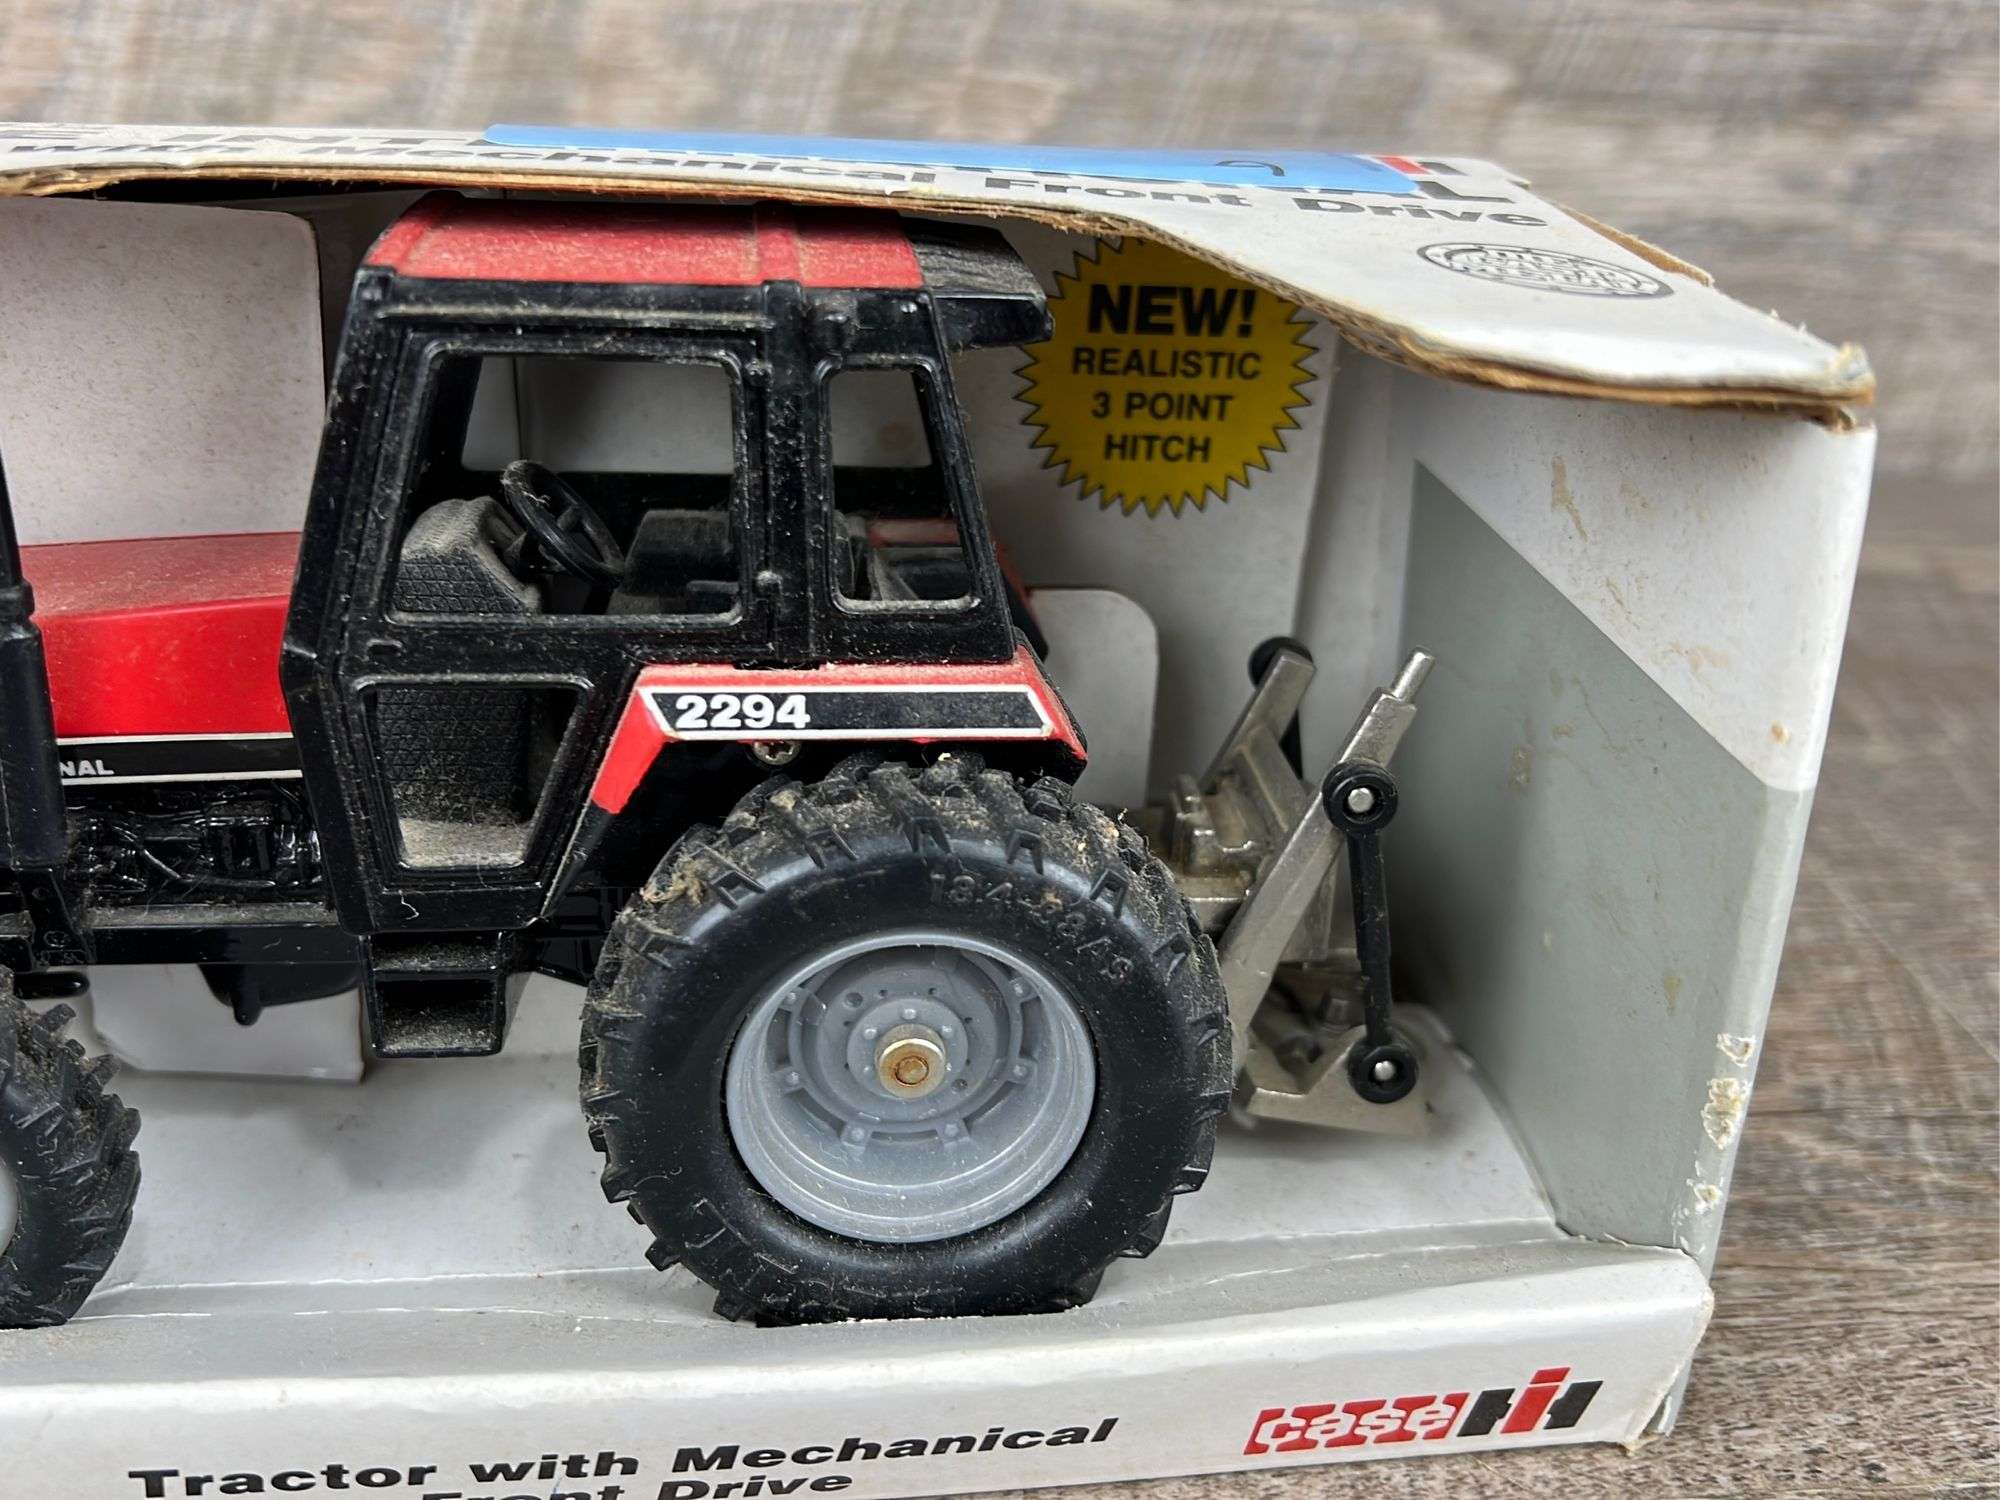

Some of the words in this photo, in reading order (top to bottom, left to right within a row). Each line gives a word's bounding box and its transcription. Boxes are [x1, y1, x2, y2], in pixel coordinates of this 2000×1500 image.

[298, 146, 937, 184] Mechanical
[984, 176, 1255, 208] Front
[1290, 197, 1548, 227] Drive
[1087, 283, 1259, 338] NEW!
[1072, 346, 1264, 381] REALISTIC
[1091, 391, 1111, 420] 3
[1124, 391, 1235, 422] POINT
[1103, 433, 1213, 463] HITCH
[674, 693, 812, 729] 2294
[128, 1461, 438, 1499] Tractor
[468, 1450, 640, 1483] with
[672, 1416, 1120, 1474] Mechanical
[656, 1474, 853, 1500] Drive
